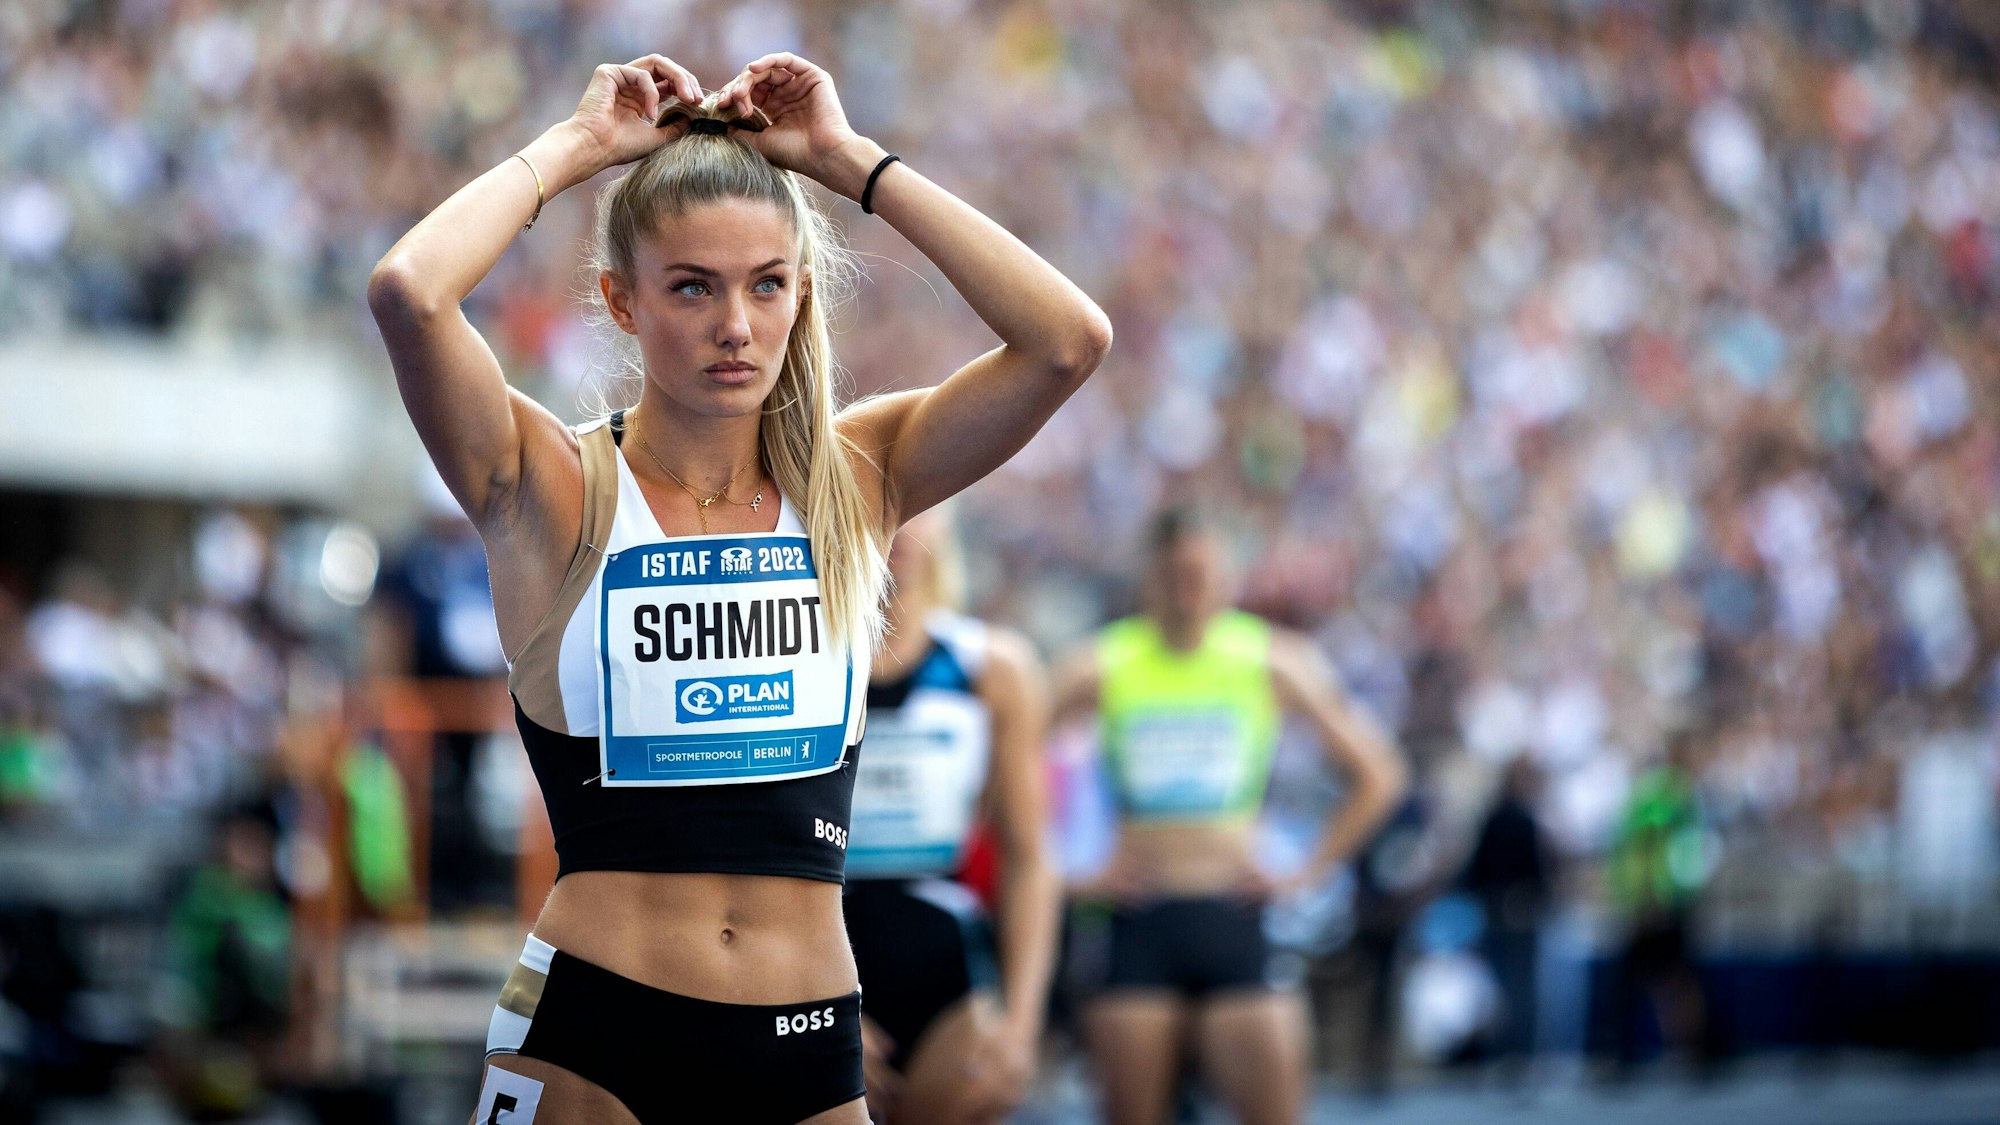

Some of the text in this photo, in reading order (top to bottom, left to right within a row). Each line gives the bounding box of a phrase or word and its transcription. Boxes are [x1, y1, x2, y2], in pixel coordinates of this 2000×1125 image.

[642, 546, 807, 578] ISTAF ISTAF 2022
[634, 597, 820, 662] SCHMIDT
[728, 680, 790, 704] PLAN
[729, 704, 789, 713] INTERNATIONAL
[655, 746, 792, 762] SPORTMETROPOLE BERLIN
[815, 818, 847, 850] BOSS
[776, 1007, 834, 1036] BOSS
